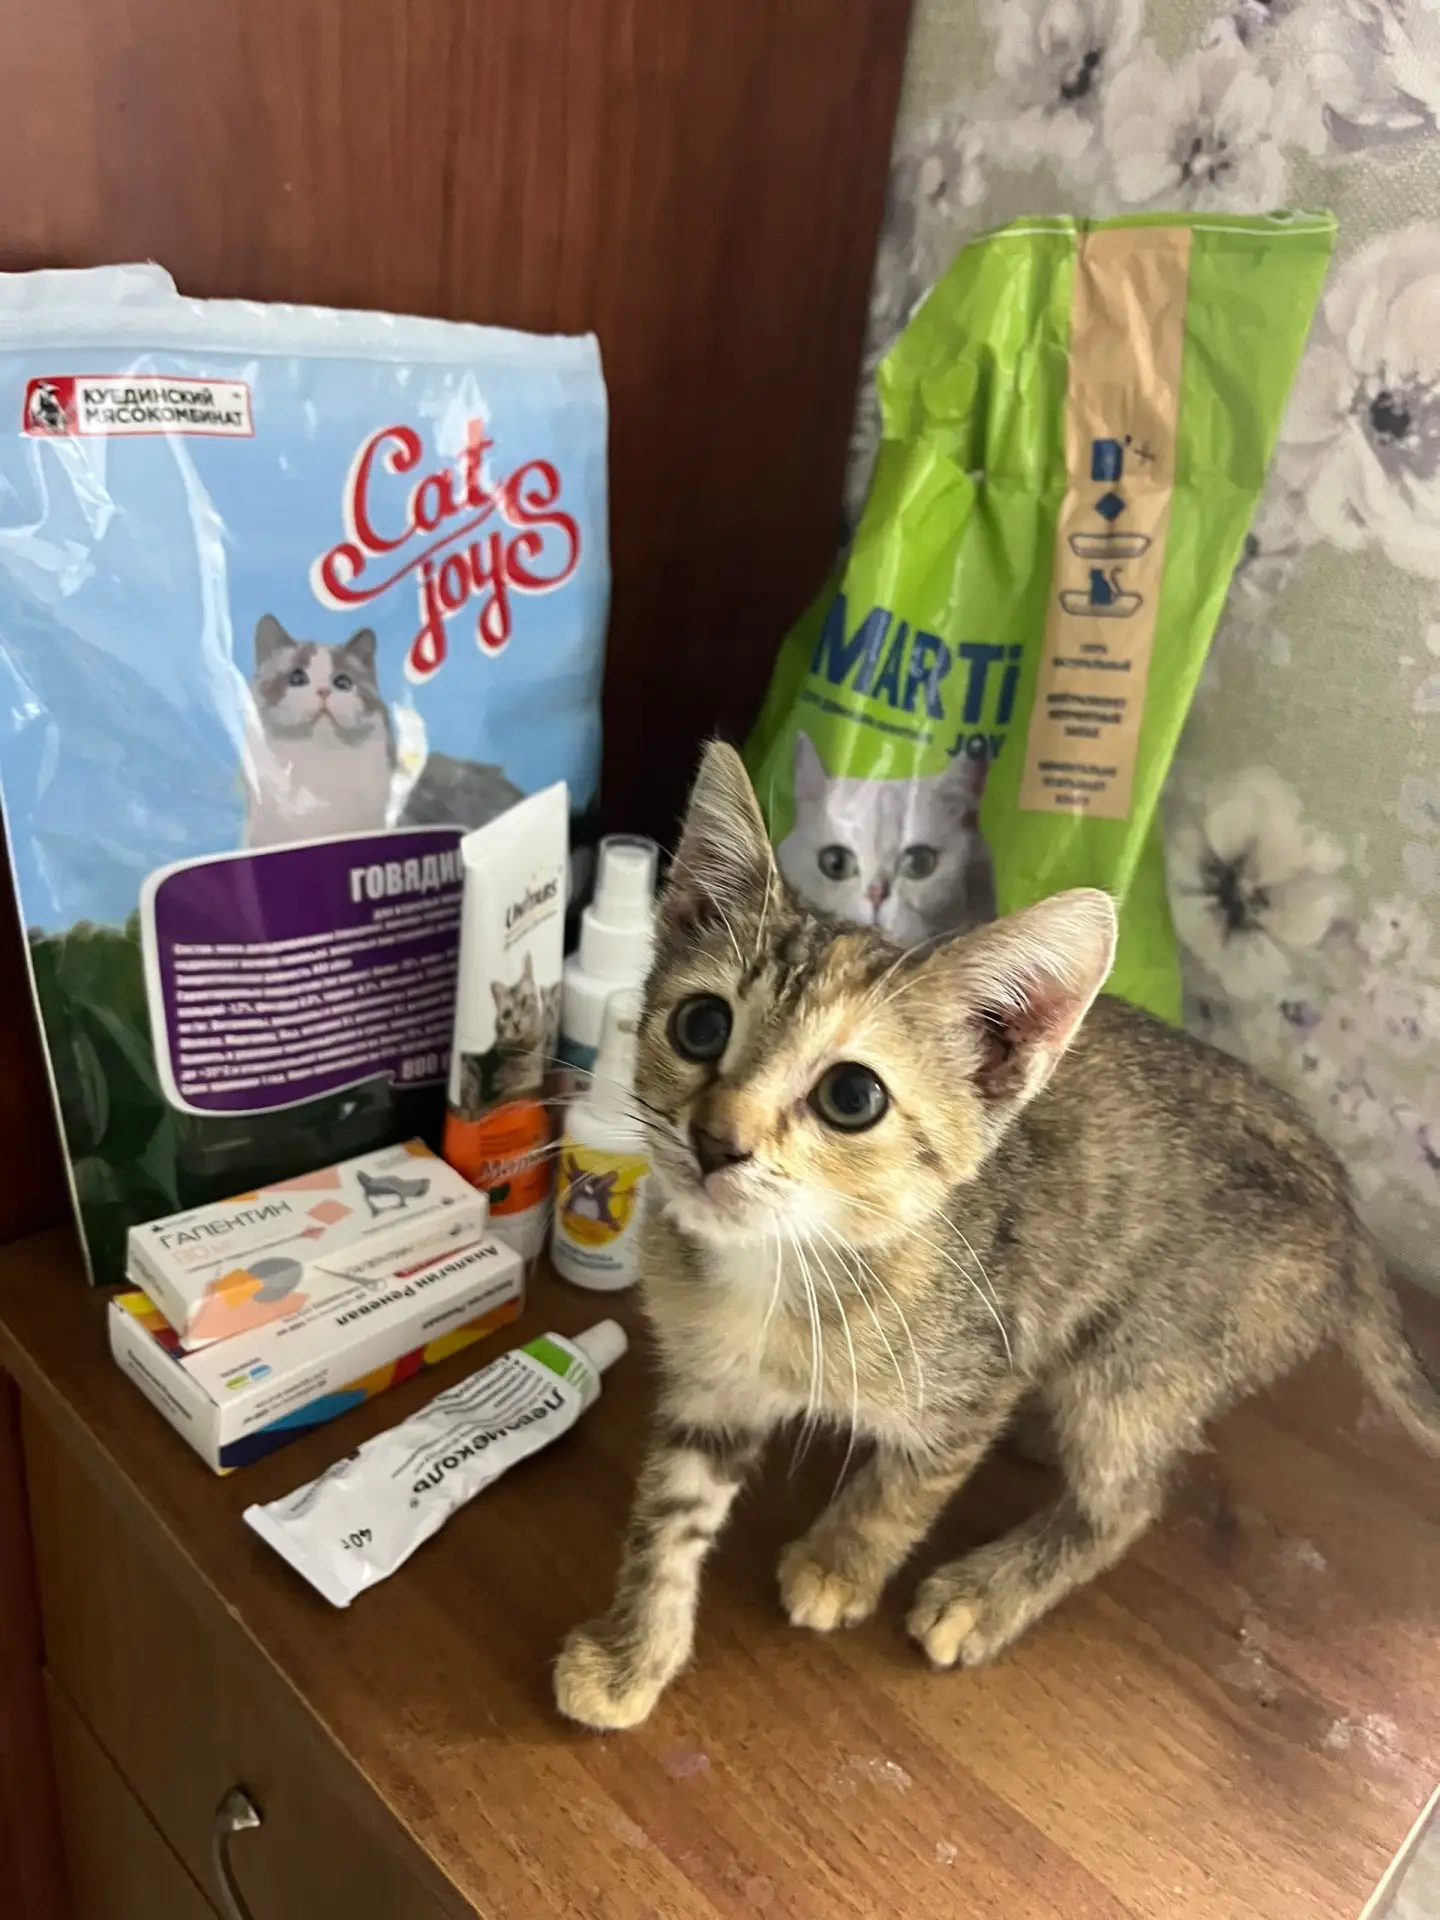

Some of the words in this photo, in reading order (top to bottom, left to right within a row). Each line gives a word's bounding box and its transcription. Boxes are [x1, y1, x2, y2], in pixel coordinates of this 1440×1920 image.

[84, 406, 244, 427] МЯСОКОМБИНАТ
[345, 418, 495, 556] Cat
[945, 732, 1006, 761] JOY
[415, 1244, 500, 1290] Анальгин
[335, 1283, 417, 1328] Реневал
[411, 1386, 566, 1496] Левомеколь
